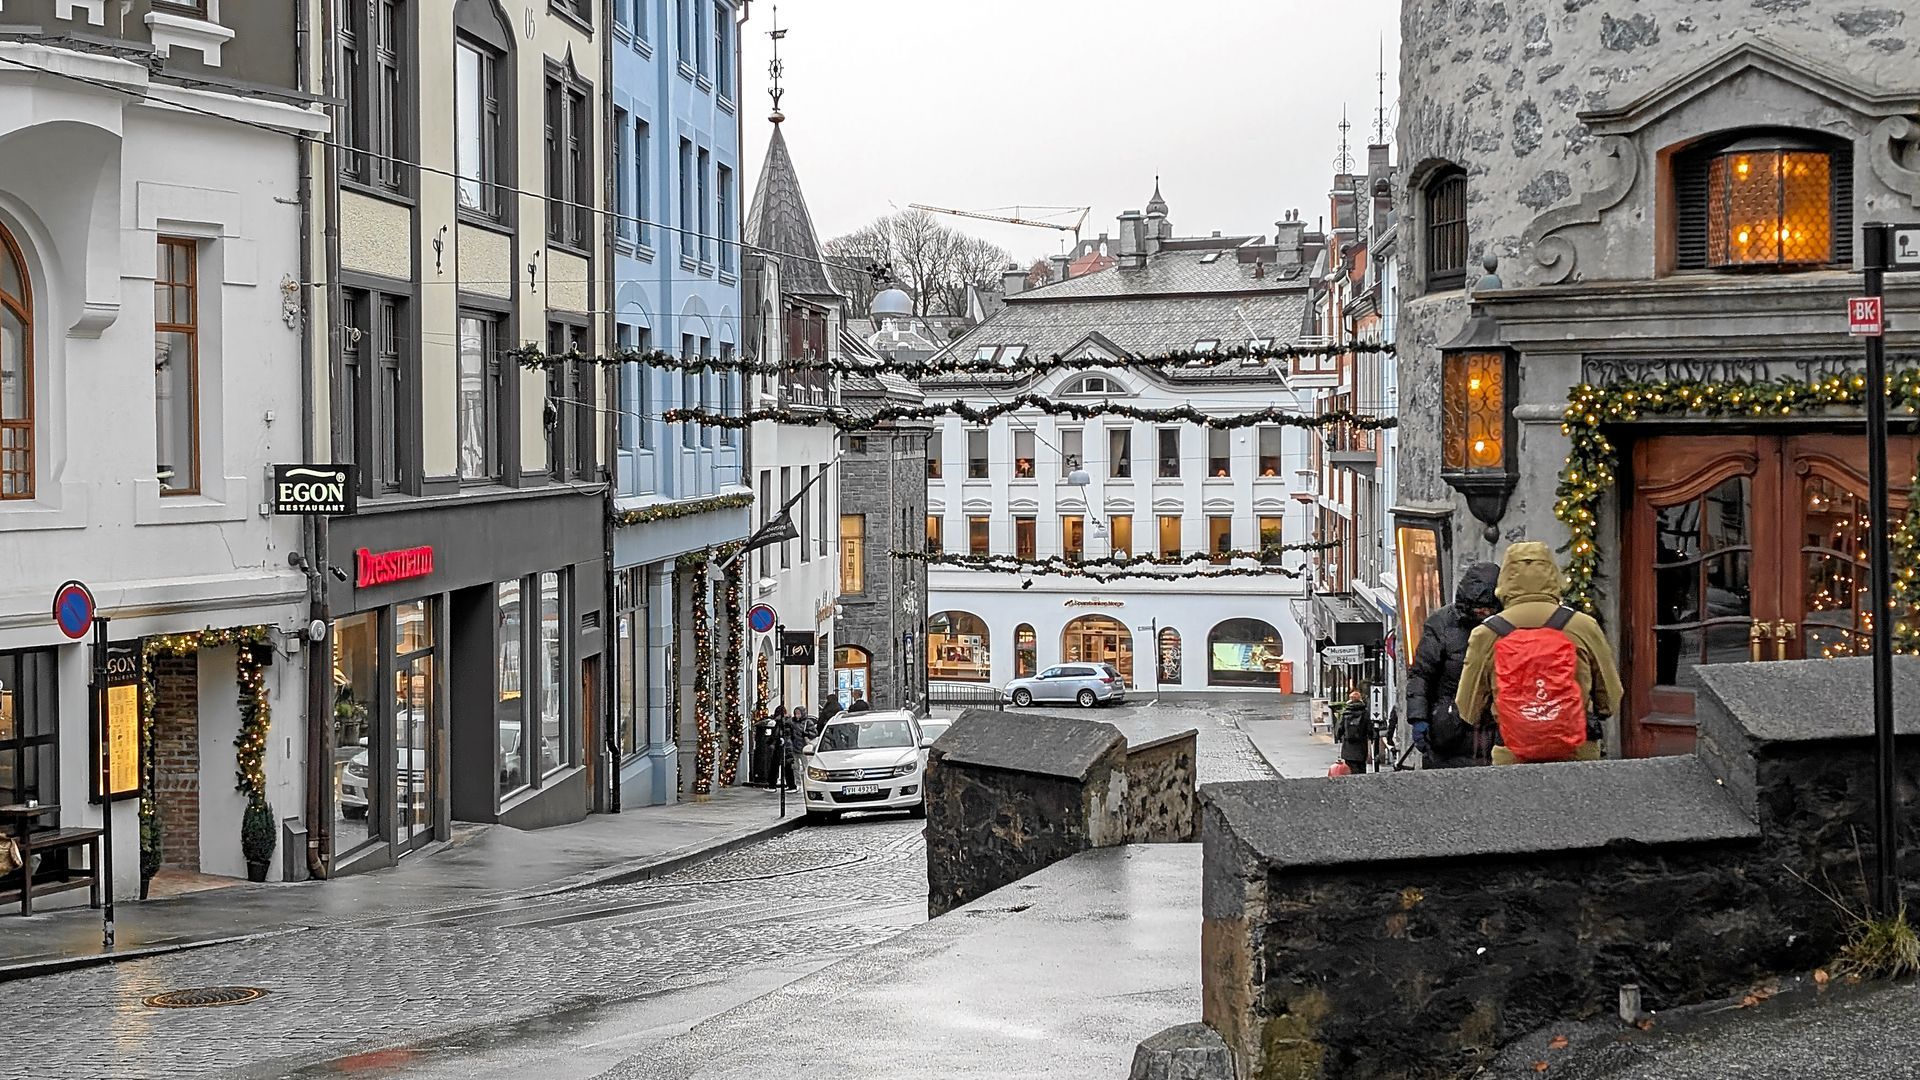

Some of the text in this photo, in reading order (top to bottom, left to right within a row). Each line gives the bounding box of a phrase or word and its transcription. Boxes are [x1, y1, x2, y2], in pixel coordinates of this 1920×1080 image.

[1856, 301, 1875, 320] BK
[279, 483, 344, 502] EGON
[279, 504, 345, 512] RESTAURANT
[357, 546, 434, 588] Dressmann
[106, 655, 137, 674] GON
